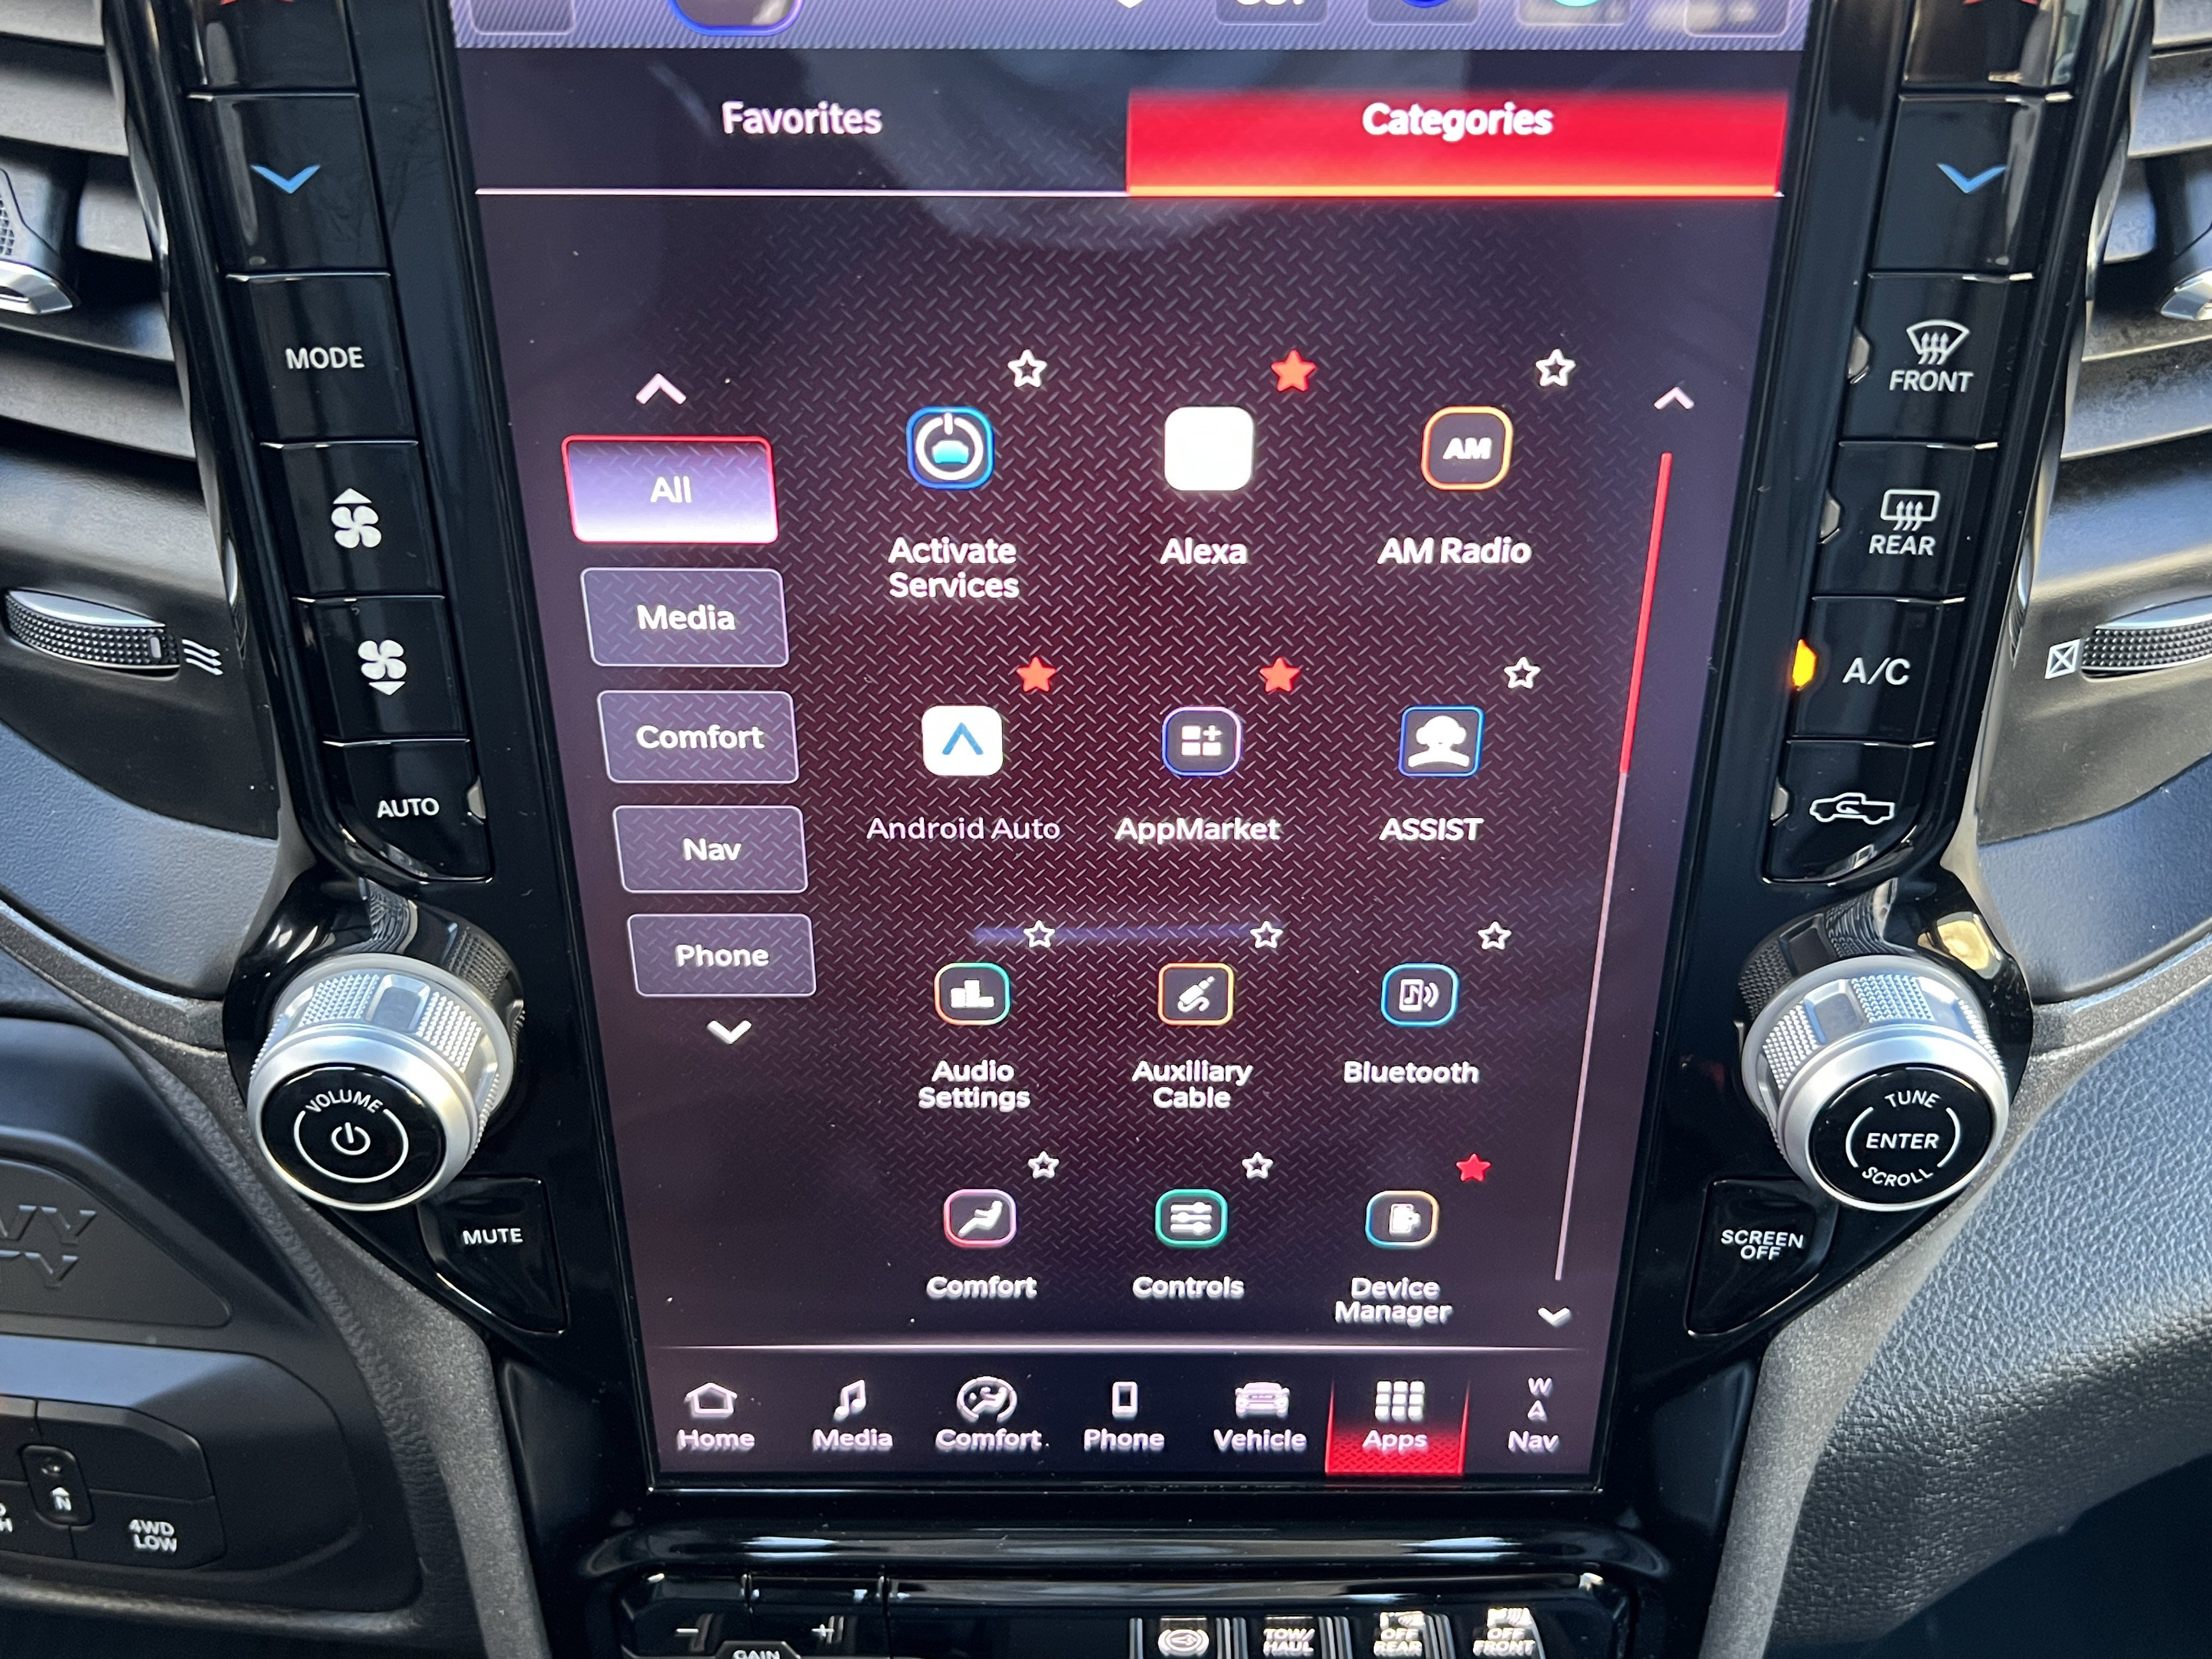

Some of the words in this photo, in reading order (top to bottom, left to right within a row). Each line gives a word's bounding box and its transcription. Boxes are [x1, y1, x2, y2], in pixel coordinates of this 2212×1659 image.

[721, 100, 884, 136] Favorites
[1362, 102, 1554, 142] Categories
[285, 347, 365, 369] MODE
[1889, 370, 1974, 392] FRONT
[1442, 438, 1492, 460] AM
[650, 475, 692, 503] All
[888, 537, 1017, 564] Activate
[1160, 537, 1248, 565] Alexa
[1377, 538, 1433, 565] AM
[1440, 537, 1532, 565] Radio
[1869, 534, 1936, 555] REAR
[889, 572, 1019, 599] Services
[636, 604, 736, 631] Media
[1842, 658, 1910, 685] A/C
[635, 724, 765, 749] Comfort
[377, 798, 439, 818] AUTO
[866, 817, 984, 840] Android
[990, 817, 1060, 839] Auto
[1114, 817, 1281, 844] AppMarket
[1379, 817, 1483, 841] ASSIST
[682, 837, 742, 861] Nav
[675, 944, 769, 967] Phone
[932, 1060, 1015, 1082] Audio
[1131, 1060, 1254, 1086] Auxiliary
[1343, 1060, 1480, 1084] Bluetooth
[305, 1089, 383, 1113] VOLUME
[918, 1086, 1031, 1111] Settings
[1152, 1086, 1232, 1109] Cable
[1884, 1090, 1941, 1108] TUNE
[1866, 1132, 1940, 1149] ENTER
[1862, 1166, 1933, 1187] SCROLL
[462, 1227, 524, 1245] MUTE
[1721, 1229, 1804, 1249] SCREEN
[1740, 1245, 1781, 1260] OFF
[926, 1275, 1038, 1299] Comfort
[1132, 1275, 1245, 1299] Controls
[1350, 1276, 1441, 1301] Device
[1333, 1301, 1454, 1328] Manager
[677, 1429, 755, 1451] Home
[812, 1429, 894, 1452] Media
[935, 1429, 1042, 1452] Comfort
[1084, 1429, 1165, 1453] Phone
[1213, 1430, 1307, 1453] Vehicle
[1362, 1430, 1429, 1454] Apps
[1508, 1431, 1560, 1453] Nav
[128, 1519, 175, 1537] 4WD
[133, 1534, 177, 1553] LOW
[1263, 1628, 1315, 1642] TOW/
[1380, 1628, 1419, 1641] OFF
[1487, 1628, 1526, 1641] OFF
[1263, 1641, 1314, 1656] HAUL
[1373, 1640, 1423, 1656] REAR
[1472, 1639, 1536, 1656] FRONT
